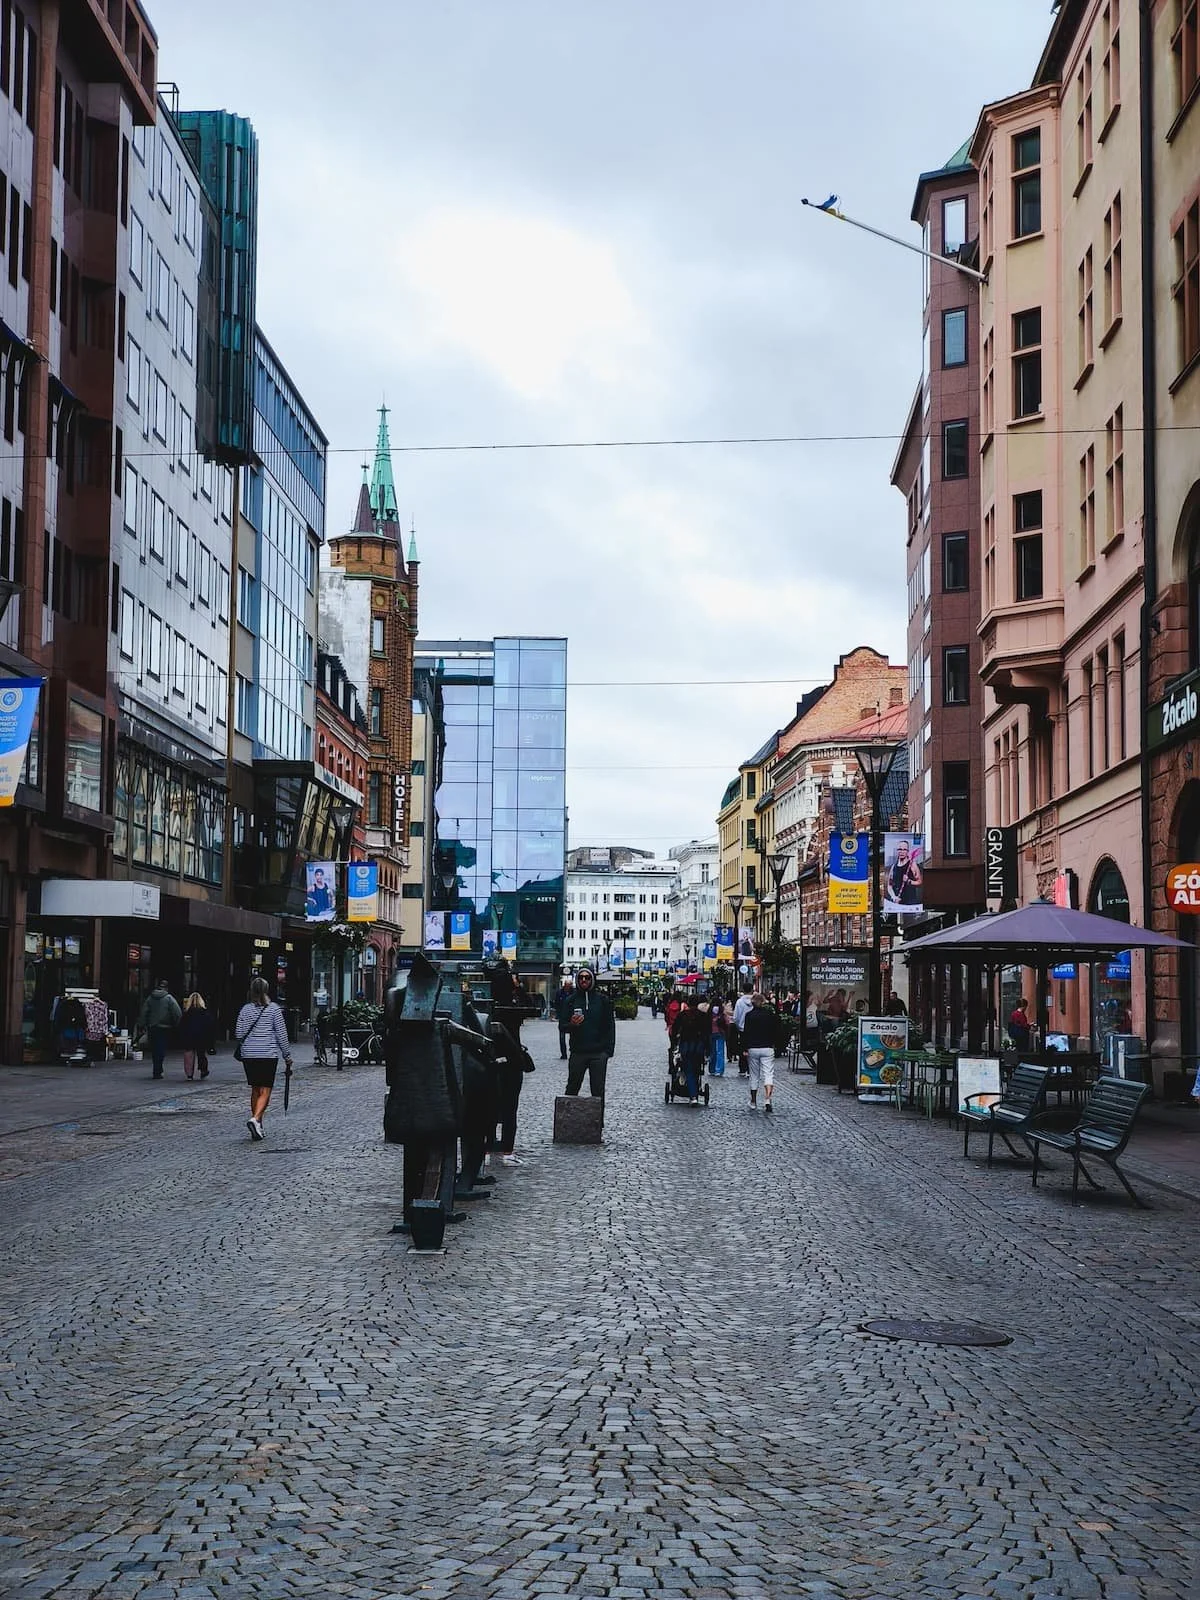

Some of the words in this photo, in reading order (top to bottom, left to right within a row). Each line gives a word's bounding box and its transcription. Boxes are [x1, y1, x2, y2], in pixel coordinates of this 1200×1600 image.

[1162, 685, 1197, 735] Zócalo
[395, 775, 405, 842] HOTELL
[988, 828, 1003, 896] GRANIT
